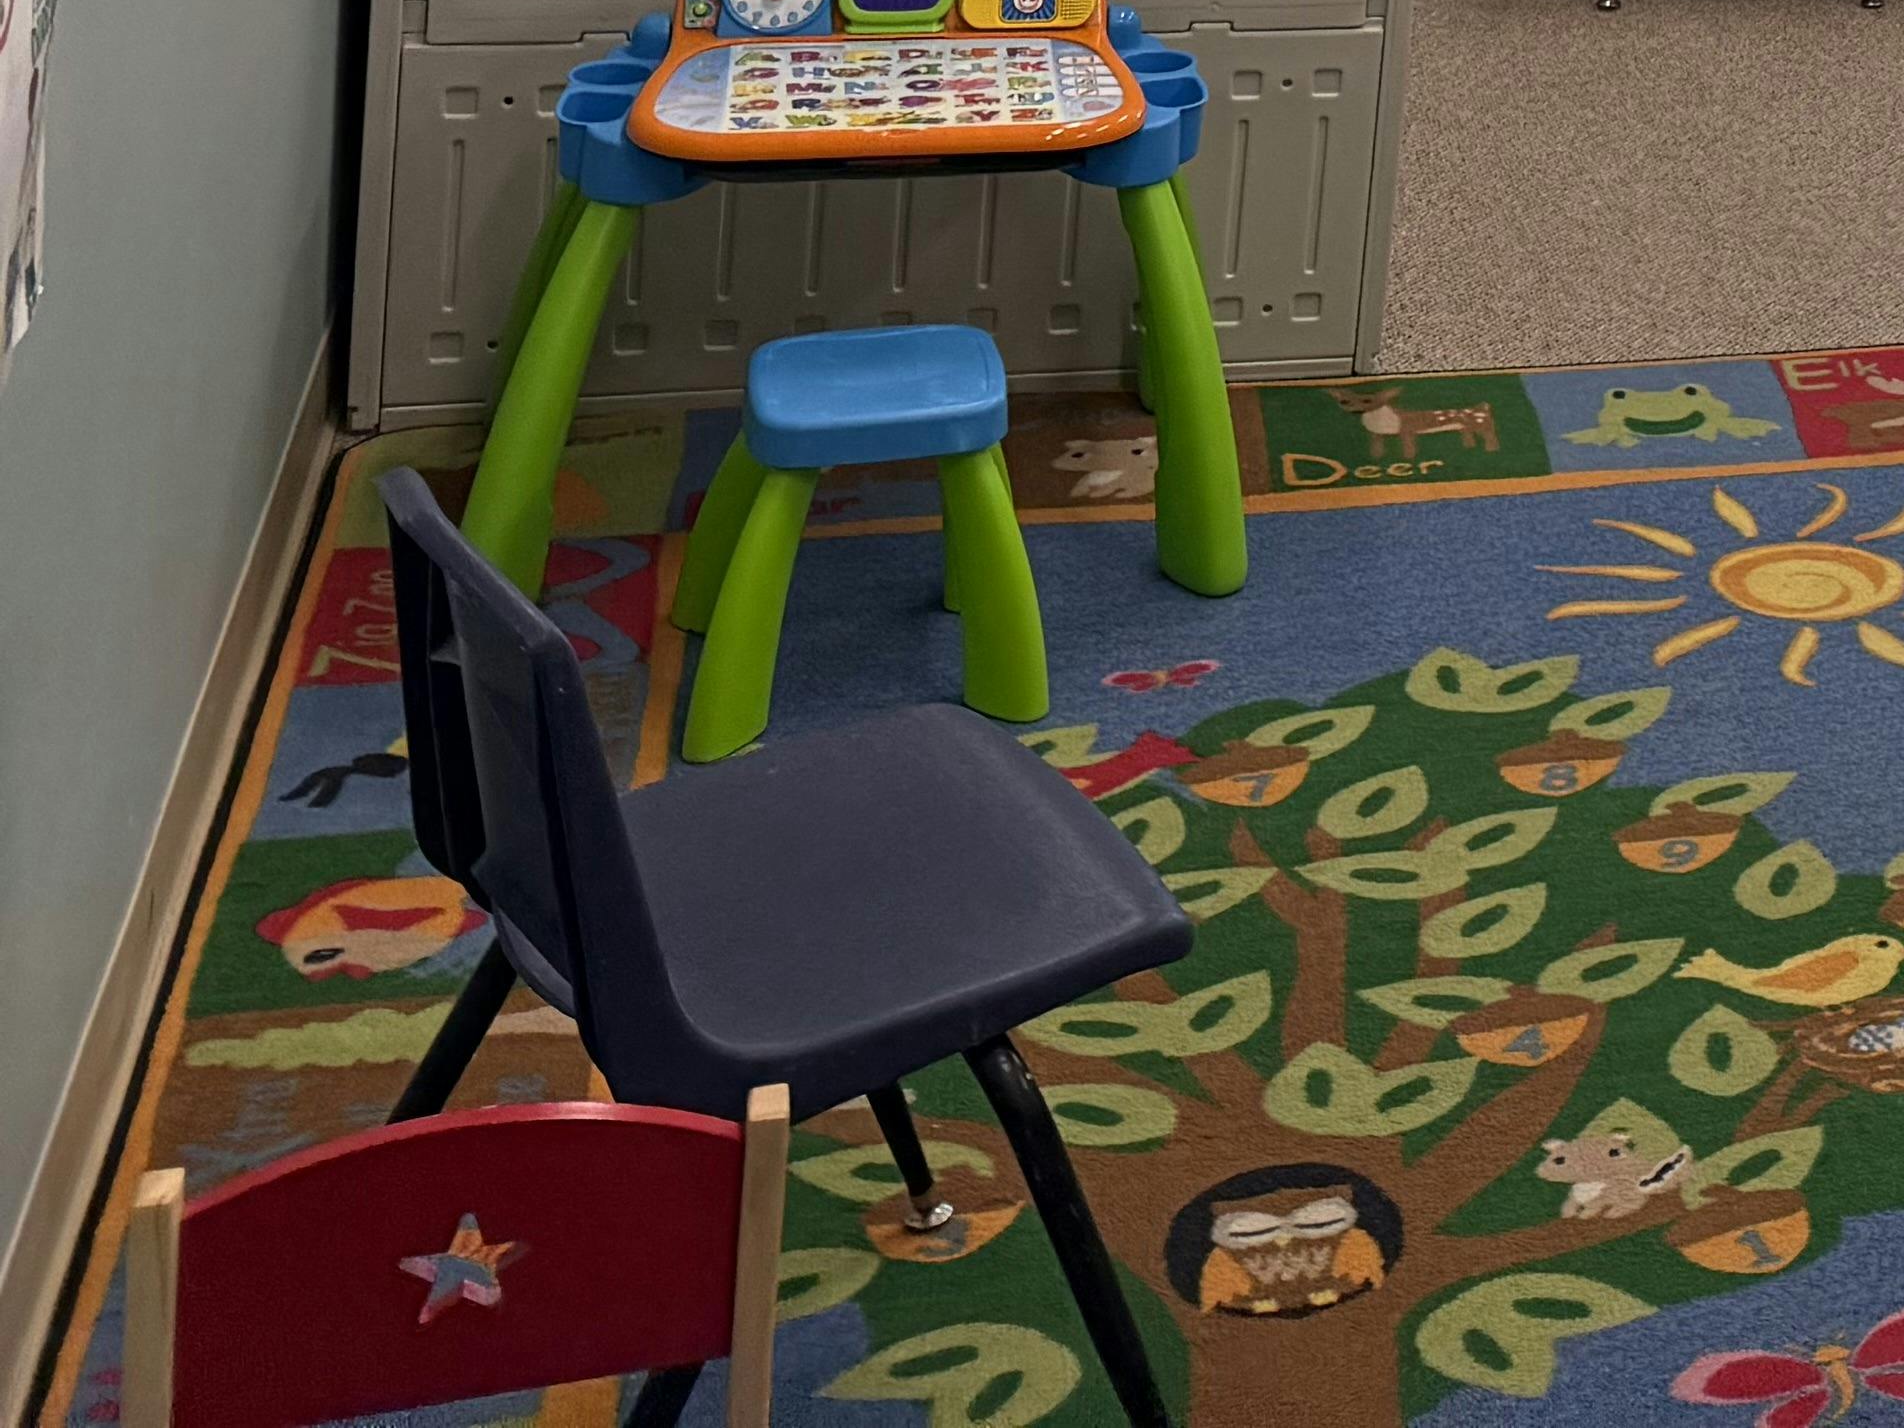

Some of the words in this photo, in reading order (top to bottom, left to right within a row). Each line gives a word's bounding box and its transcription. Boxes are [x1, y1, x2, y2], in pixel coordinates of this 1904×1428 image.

[1779, 357, 1883, 391] Elk
[1282, 453, 1444, 487] Deer
[1231, 772, 1275, 801] 7
[1539, 765, 1578, 791] 8
[1662, 840, 1698, 865] 9
[1503, 1025, 1548, 1060] 4
[1737, 1230, 1781, 1267] 1
